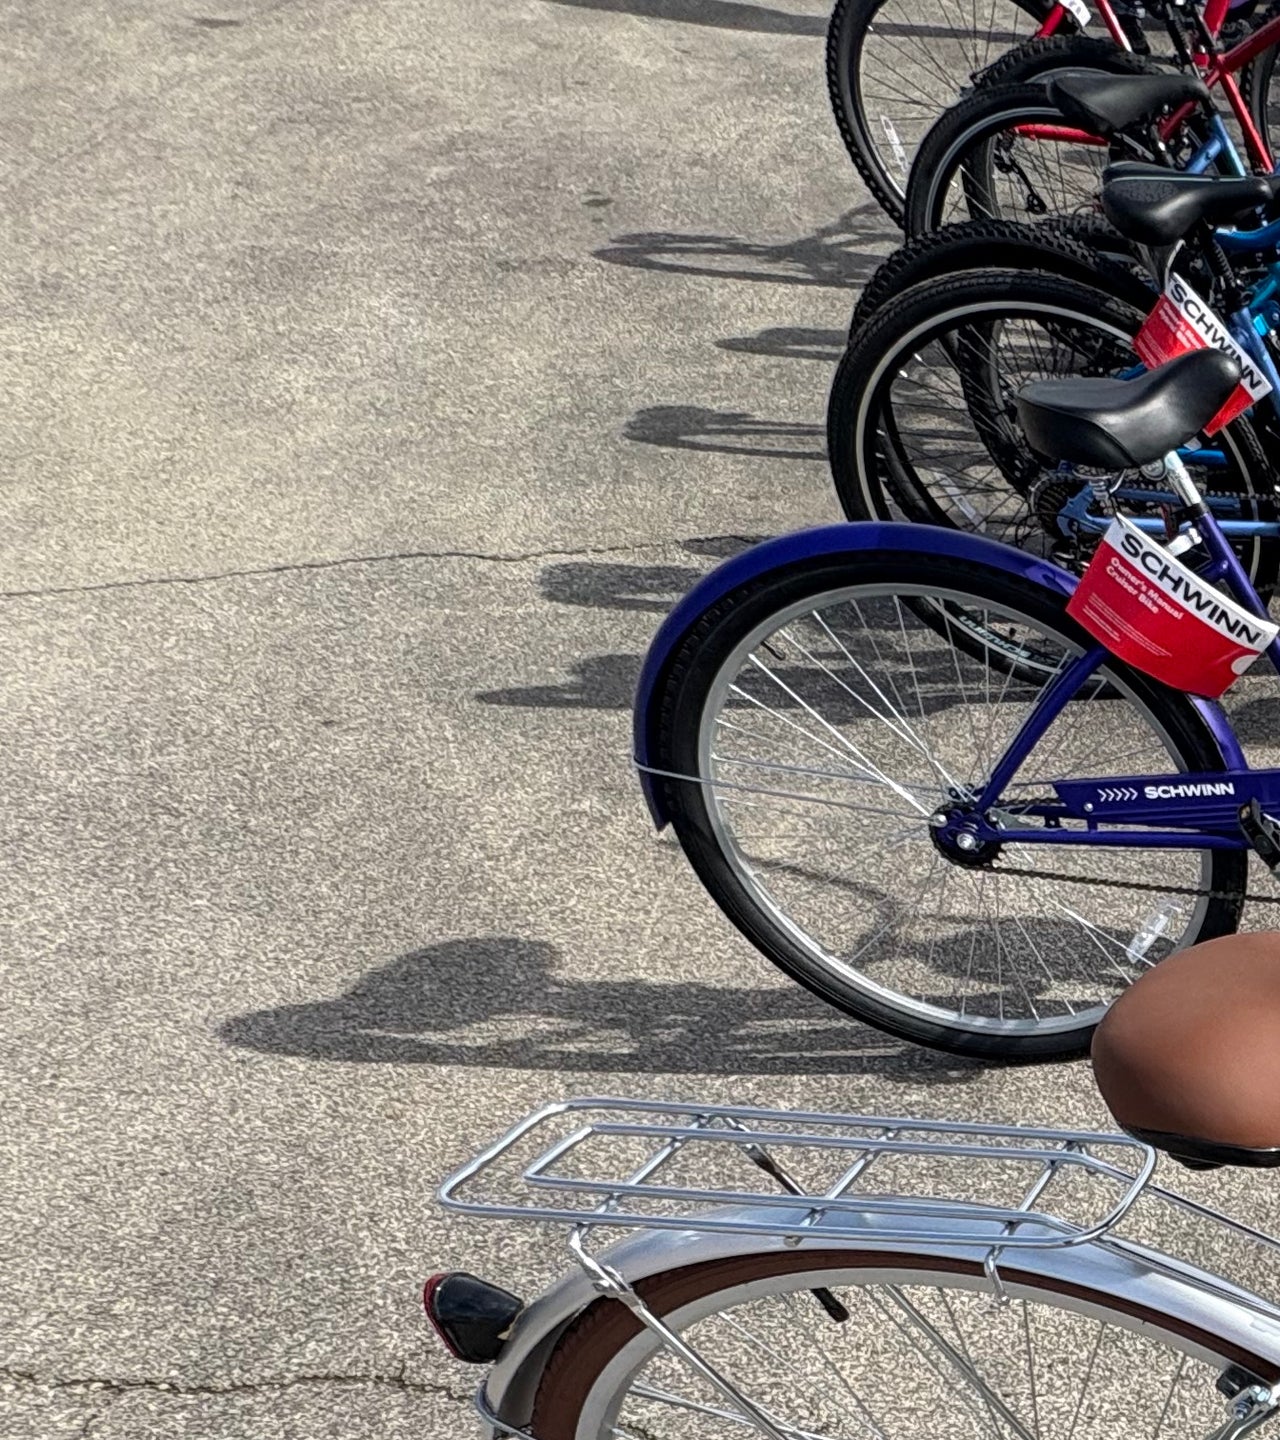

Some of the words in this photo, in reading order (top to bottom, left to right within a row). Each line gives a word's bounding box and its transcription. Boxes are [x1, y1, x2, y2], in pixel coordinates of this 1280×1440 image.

[1105, 565, 1139, 597] Cruiser
[1137, 593, 1160, 615] Bike
[1110, 556, 1148, 593] Owner's
[1146, 588, 1185, 621] Manual
[1120, 532, 1262, 646] SCHWINN
[1144, 782, 1236, 800] SCHWINN
